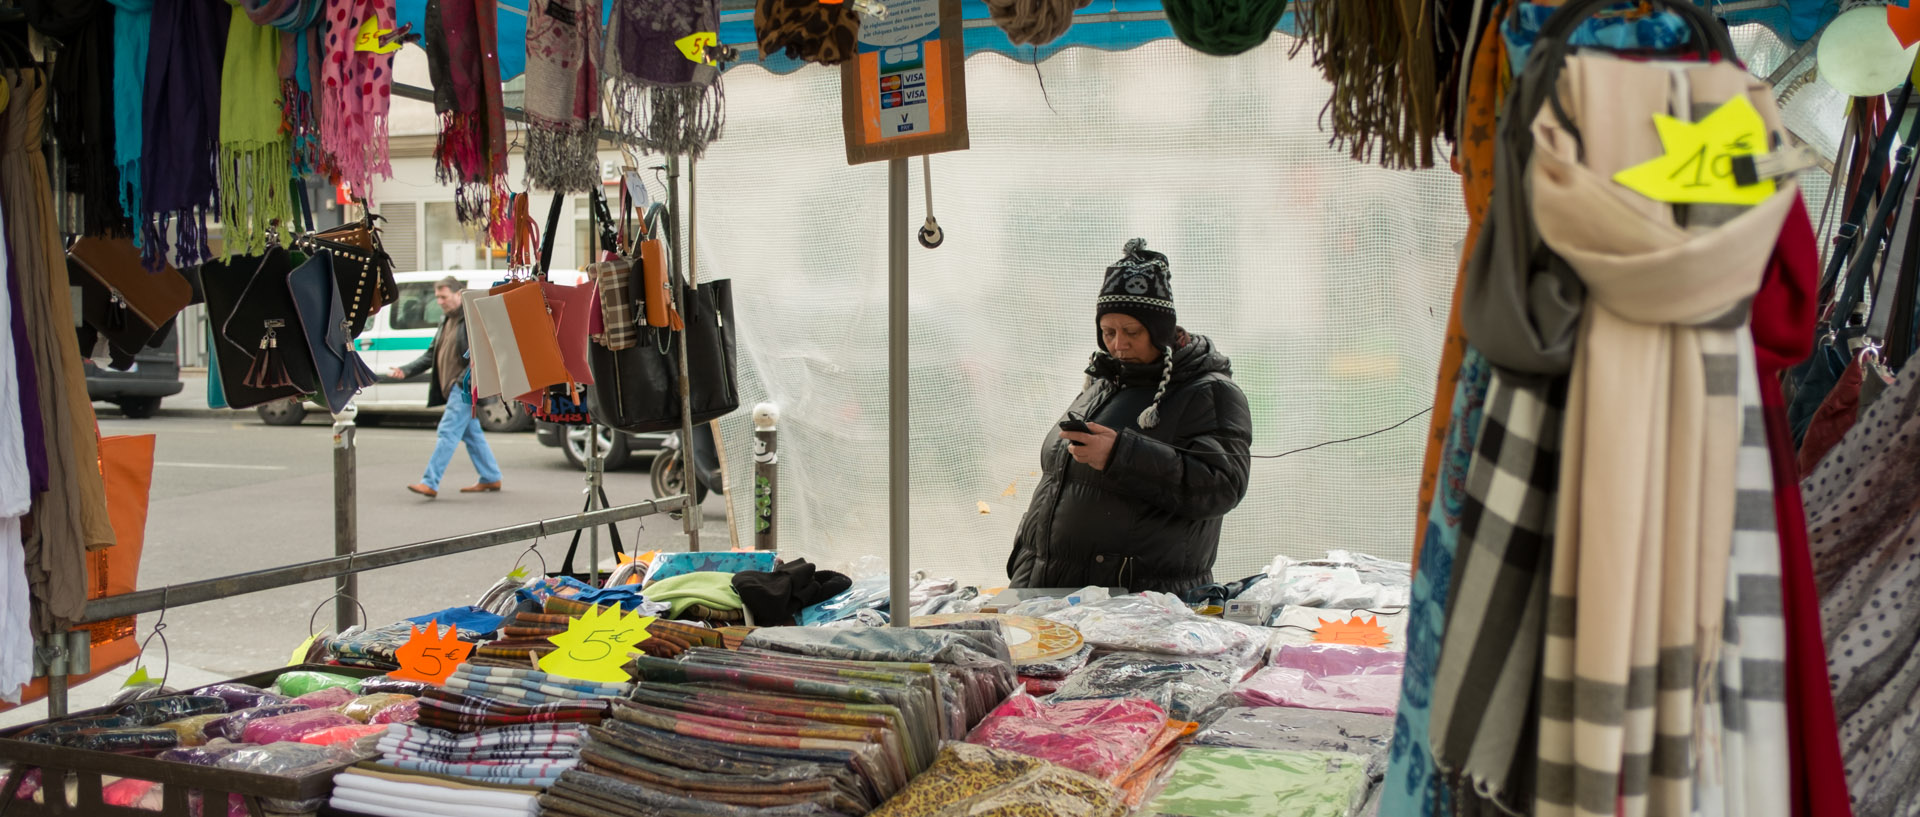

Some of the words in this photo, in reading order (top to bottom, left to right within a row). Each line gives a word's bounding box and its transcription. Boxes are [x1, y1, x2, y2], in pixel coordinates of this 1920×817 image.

[905, 73, 924, 83] VISA
[906, 90, 925, 99] VISA
[901, 113, 909, 123] V
